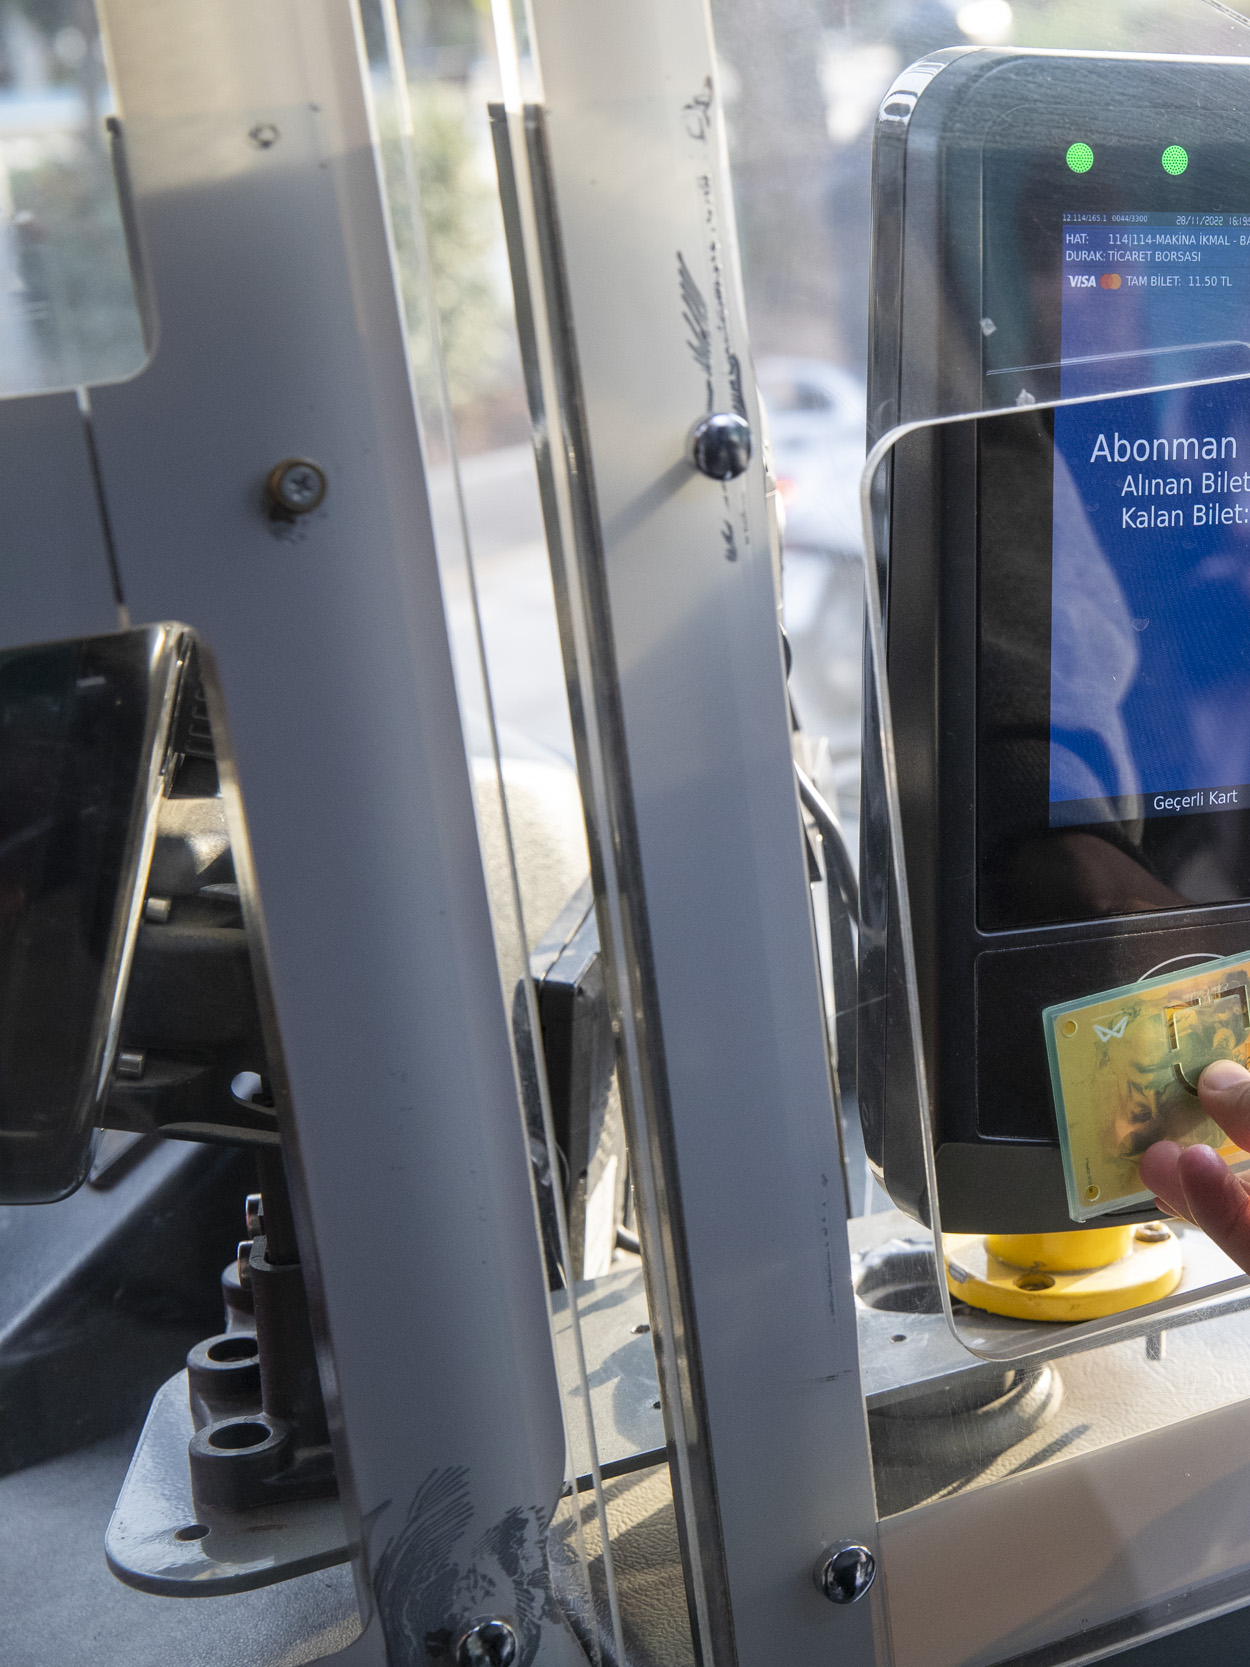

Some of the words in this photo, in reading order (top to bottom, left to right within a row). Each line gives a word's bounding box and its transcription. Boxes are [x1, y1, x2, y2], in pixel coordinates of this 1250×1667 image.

[1111, 214, 1148, 223] 0044/3300
[1176, 215, 1224, 226] 28/11/2022
[1066, 233, 1089, 245] HAT:
[1199, 232, 1231, 246] İKMAL
[1065, 251, 1106, 263] DURAK:
[1108, 249, 1153, 263] TİCARET
[1155, 251, 1202, 263] BORSASI
[1067, 275, 1097, 288] VISA
[1126, 275, 1148, 287] TAM
[1150, 273, 1182, 287] BİLET:
[1188, 275, 1218, 288] 11.50
[1220, 276, 1233, 288] TL
[1090, 432, 1237, 463] Abonman
[1121, 473, 1192, 497] Alınan
[1122, 506, 1184, 529] Kalan
[1193, 503, 1249, 526] Bilet:
[1153, 791, 1204, 812] Geçerli
[1209, 790, 1238, 805] Kart
